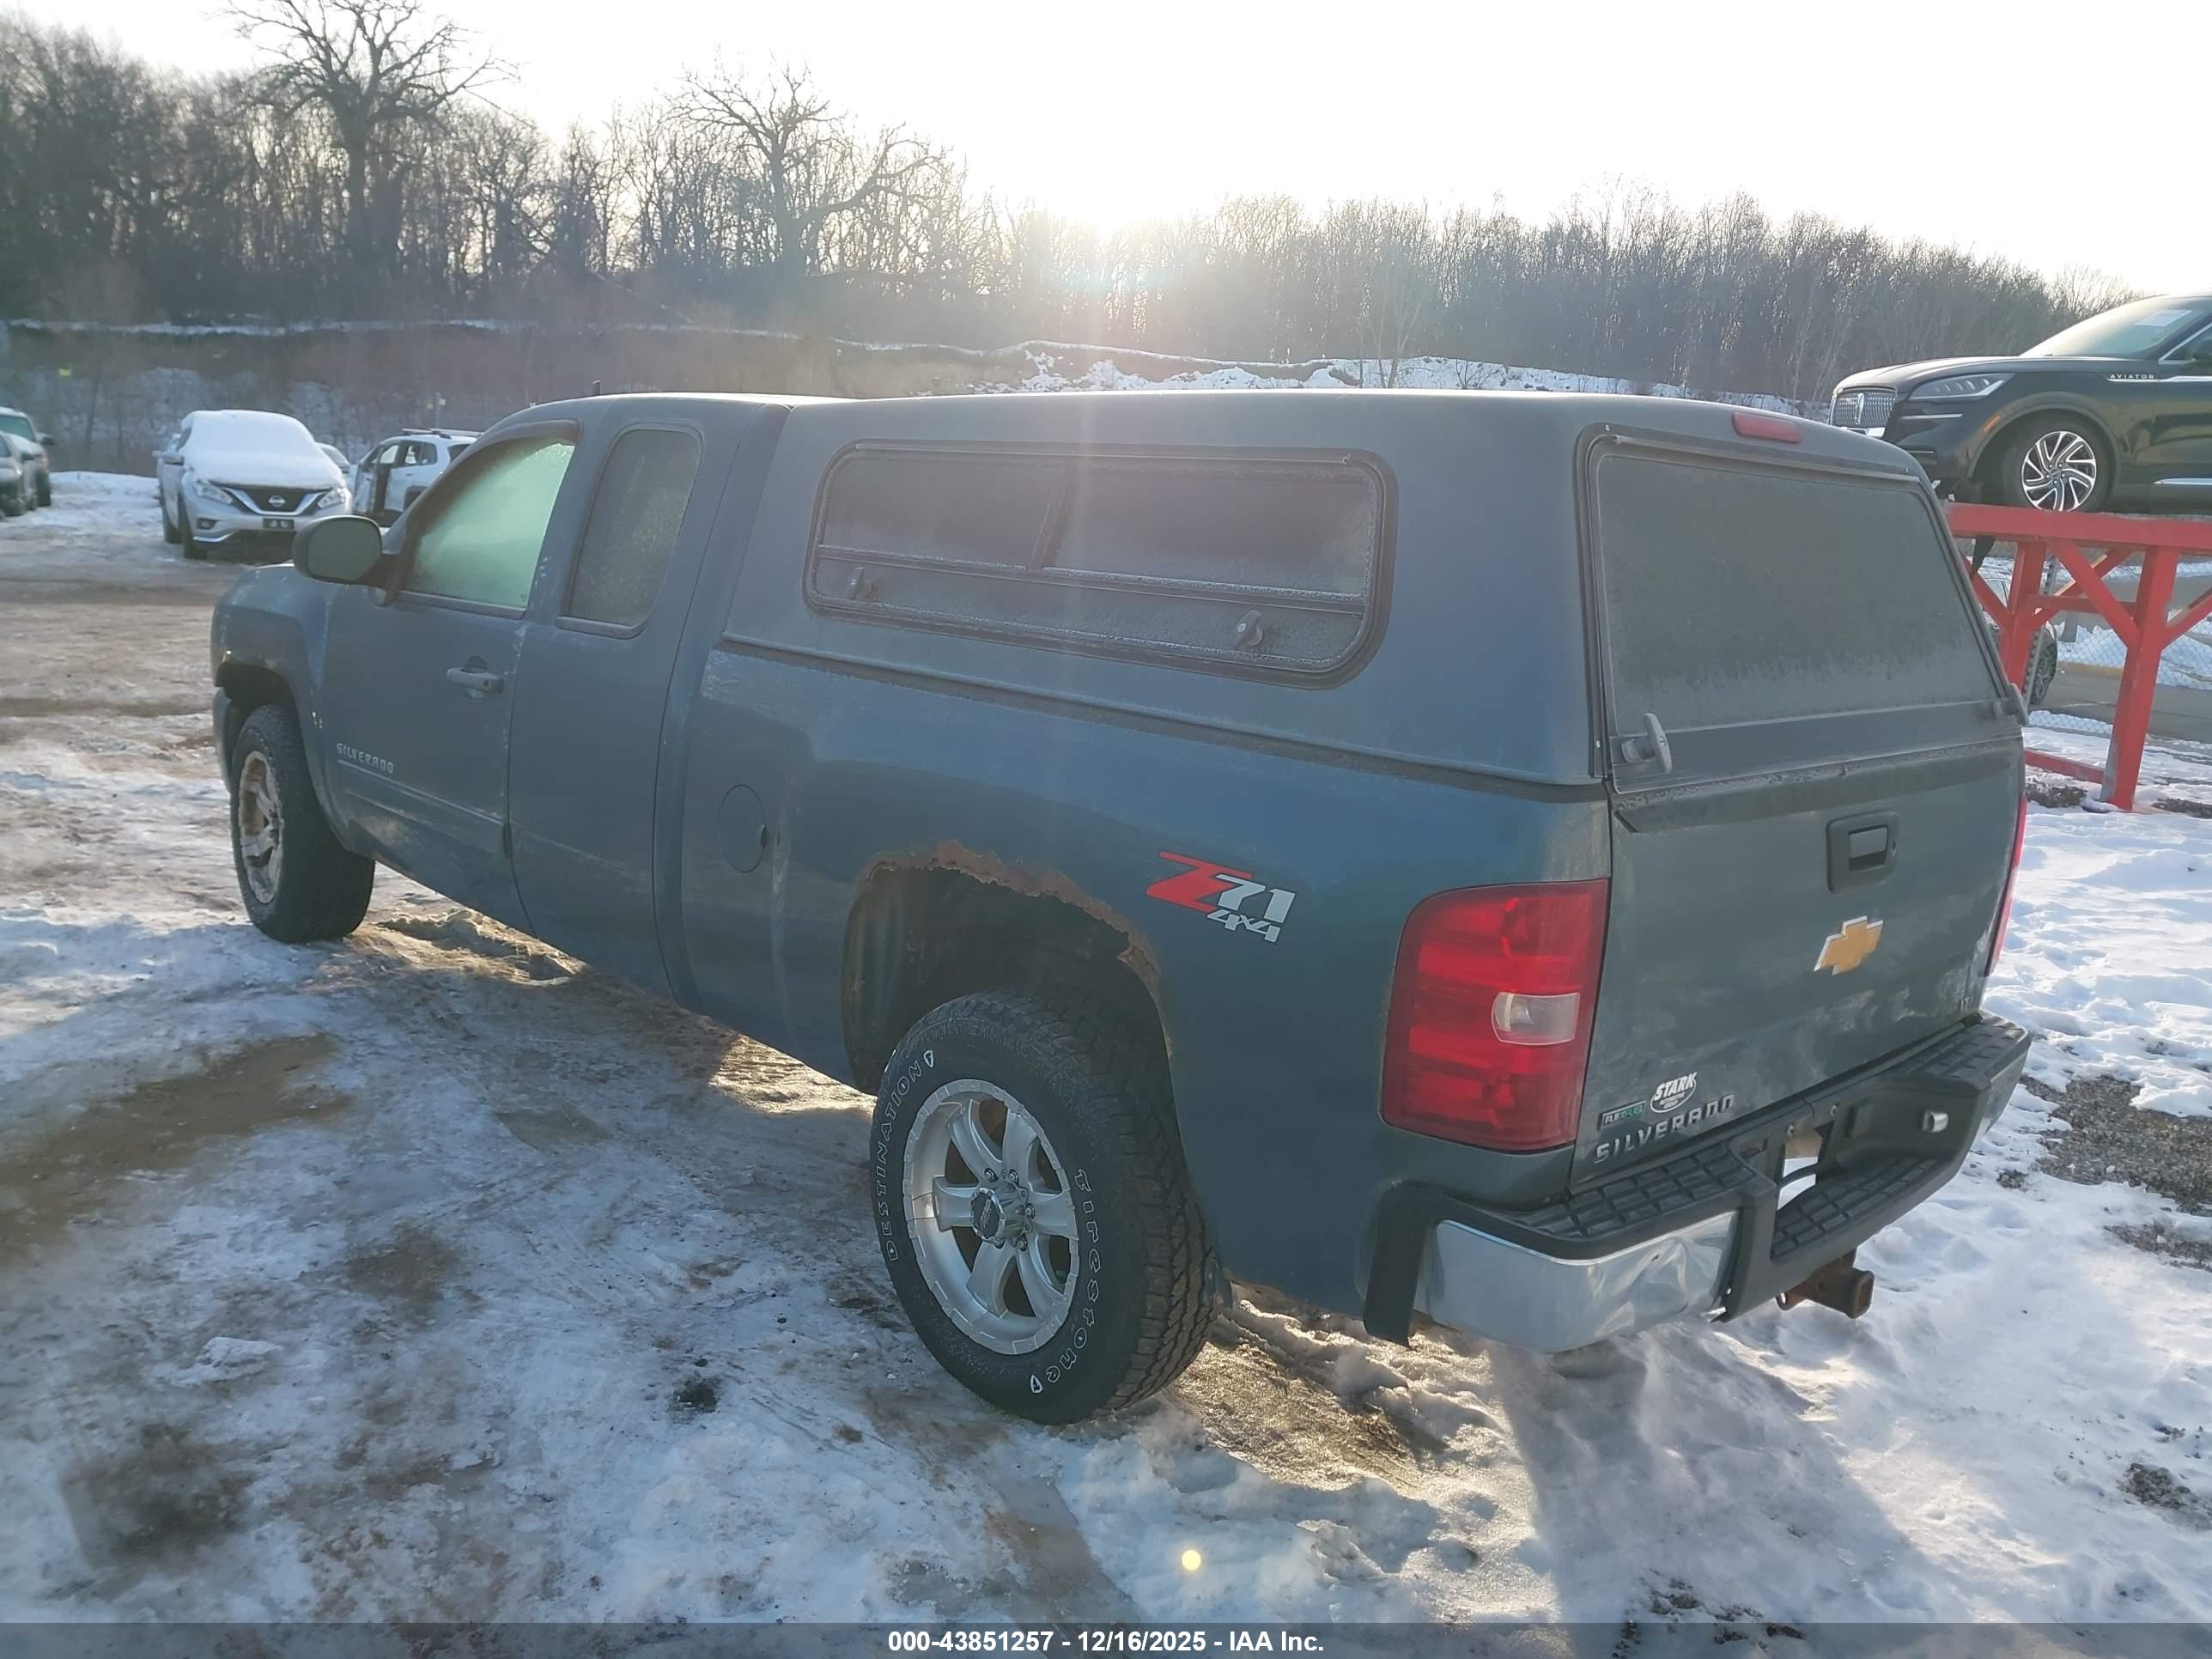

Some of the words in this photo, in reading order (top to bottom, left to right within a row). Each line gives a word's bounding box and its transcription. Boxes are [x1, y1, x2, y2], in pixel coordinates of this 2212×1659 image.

[336, 743, 394, 774] SILVERADO
[1146, 851, 1296, 924] Z71
[1654, 1072, 1698, 1101] STARK
[876, 1060, 923, 1261] DESTINATION
[1594, 1094, 1735, 1164] SILVERADO
